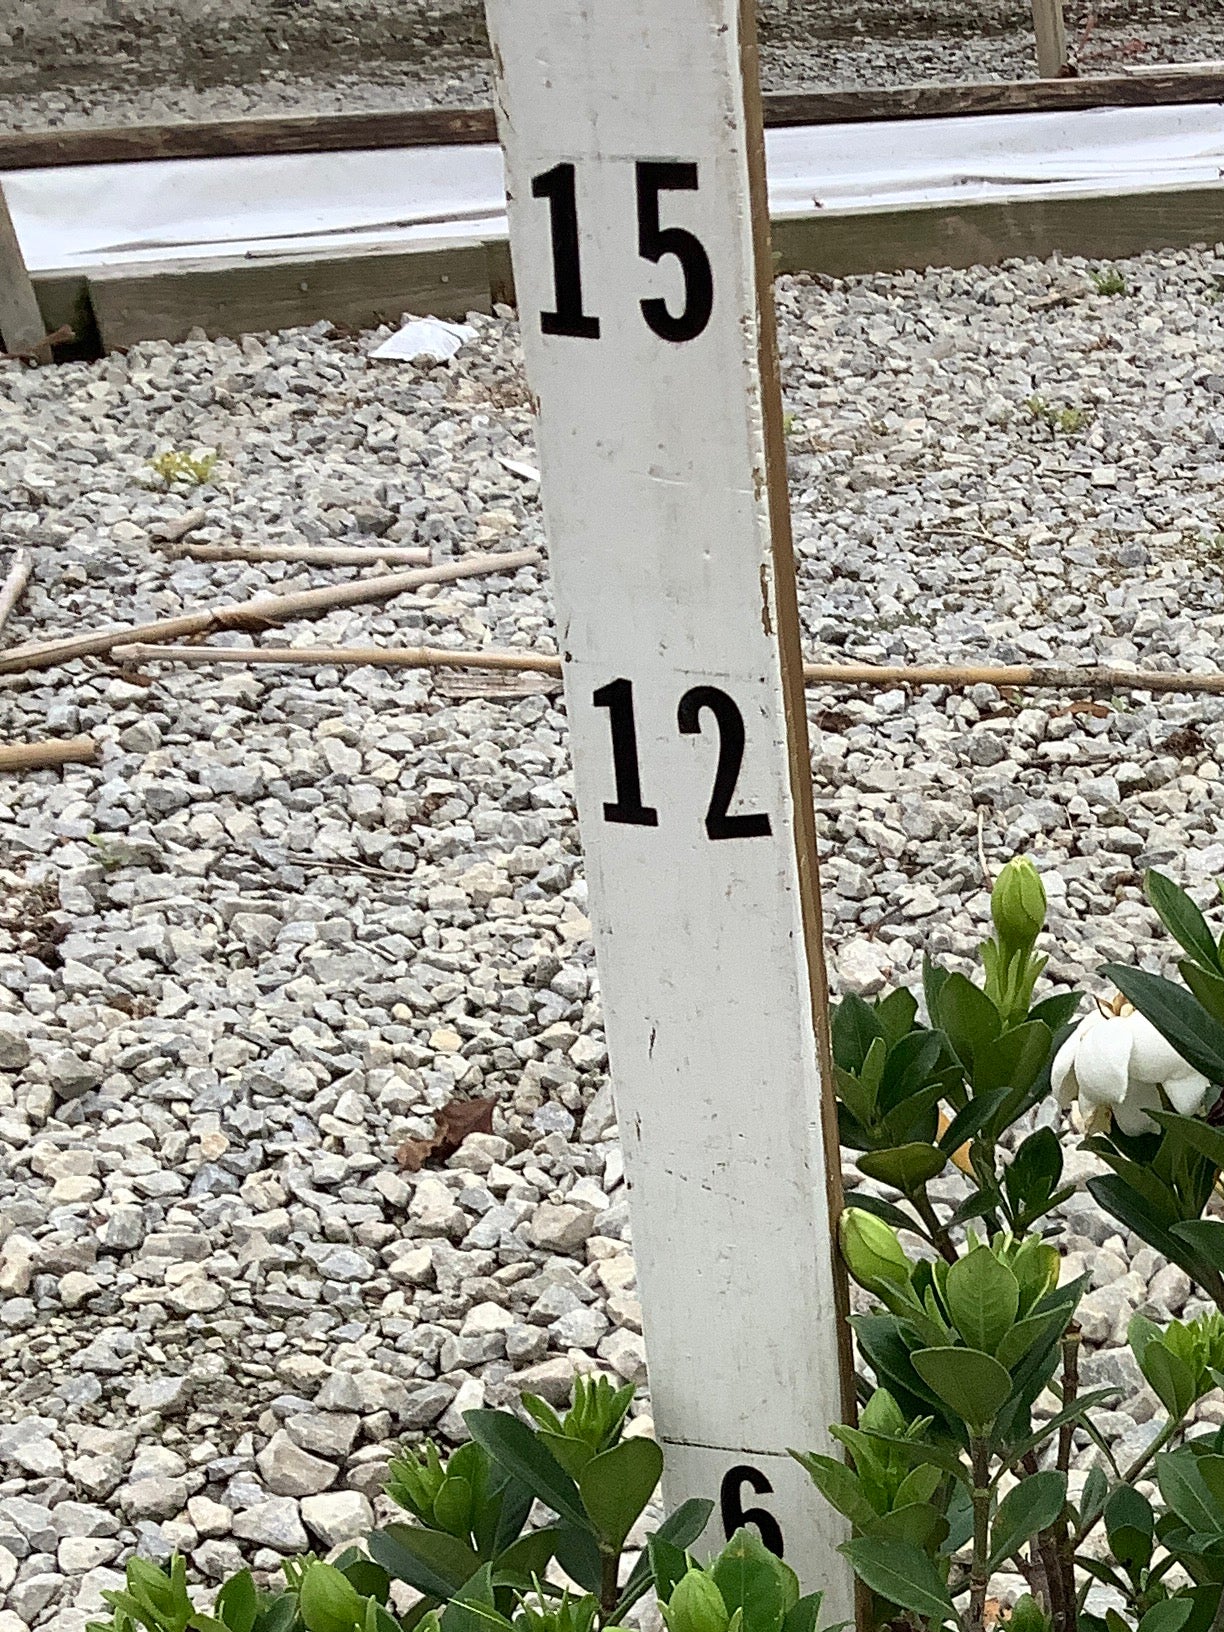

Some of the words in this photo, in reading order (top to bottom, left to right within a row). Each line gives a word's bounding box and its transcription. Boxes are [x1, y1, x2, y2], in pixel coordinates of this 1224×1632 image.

[530, 160, 715, 343] 15
[591, 677, 773, 841] 12
[720, 1465, 784, 1560] 6
